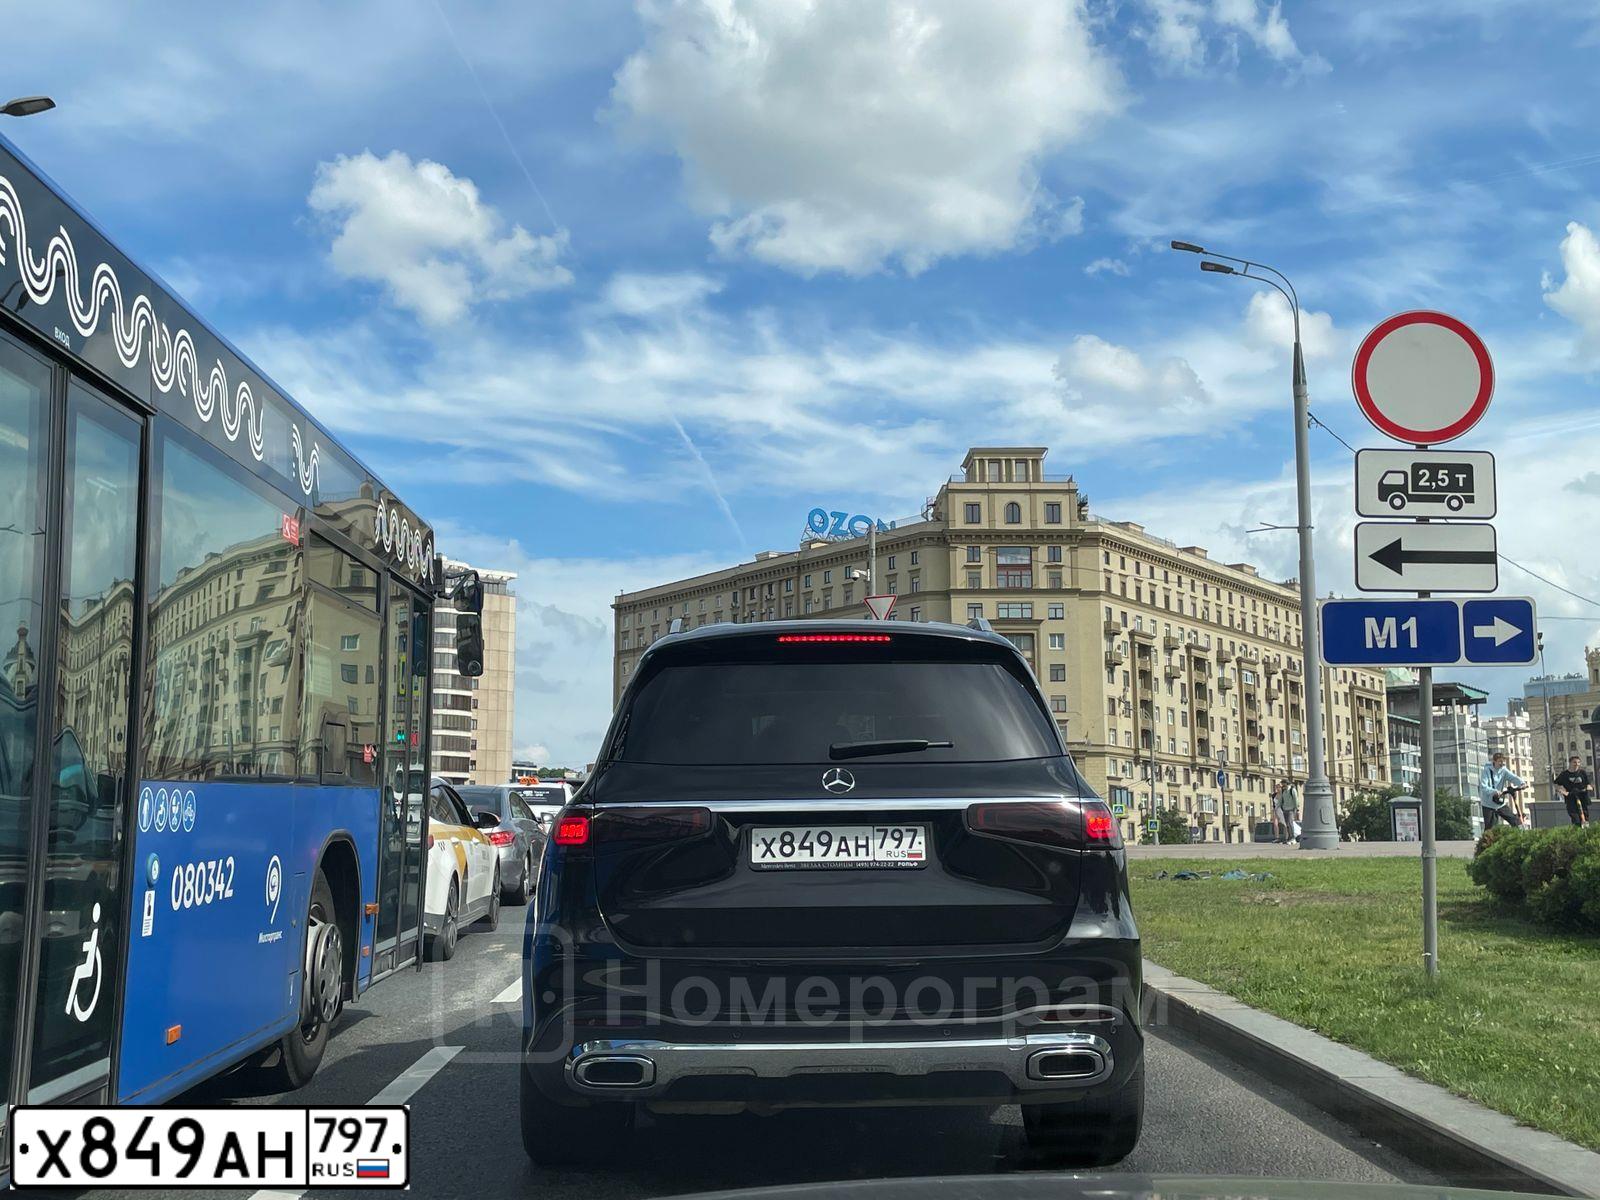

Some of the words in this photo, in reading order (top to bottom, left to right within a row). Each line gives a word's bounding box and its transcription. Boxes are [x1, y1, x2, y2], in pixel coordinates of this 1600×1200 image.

[1418, 469, 1449, 489] 2,5
[1364, 616, 1418, 649] М1
[761, 830, 870, 858] Х849АН
[876, 828, 918, 849] 797
[886, 850, 906, 858] RUS
[171, 855, 235, 911] 080342
